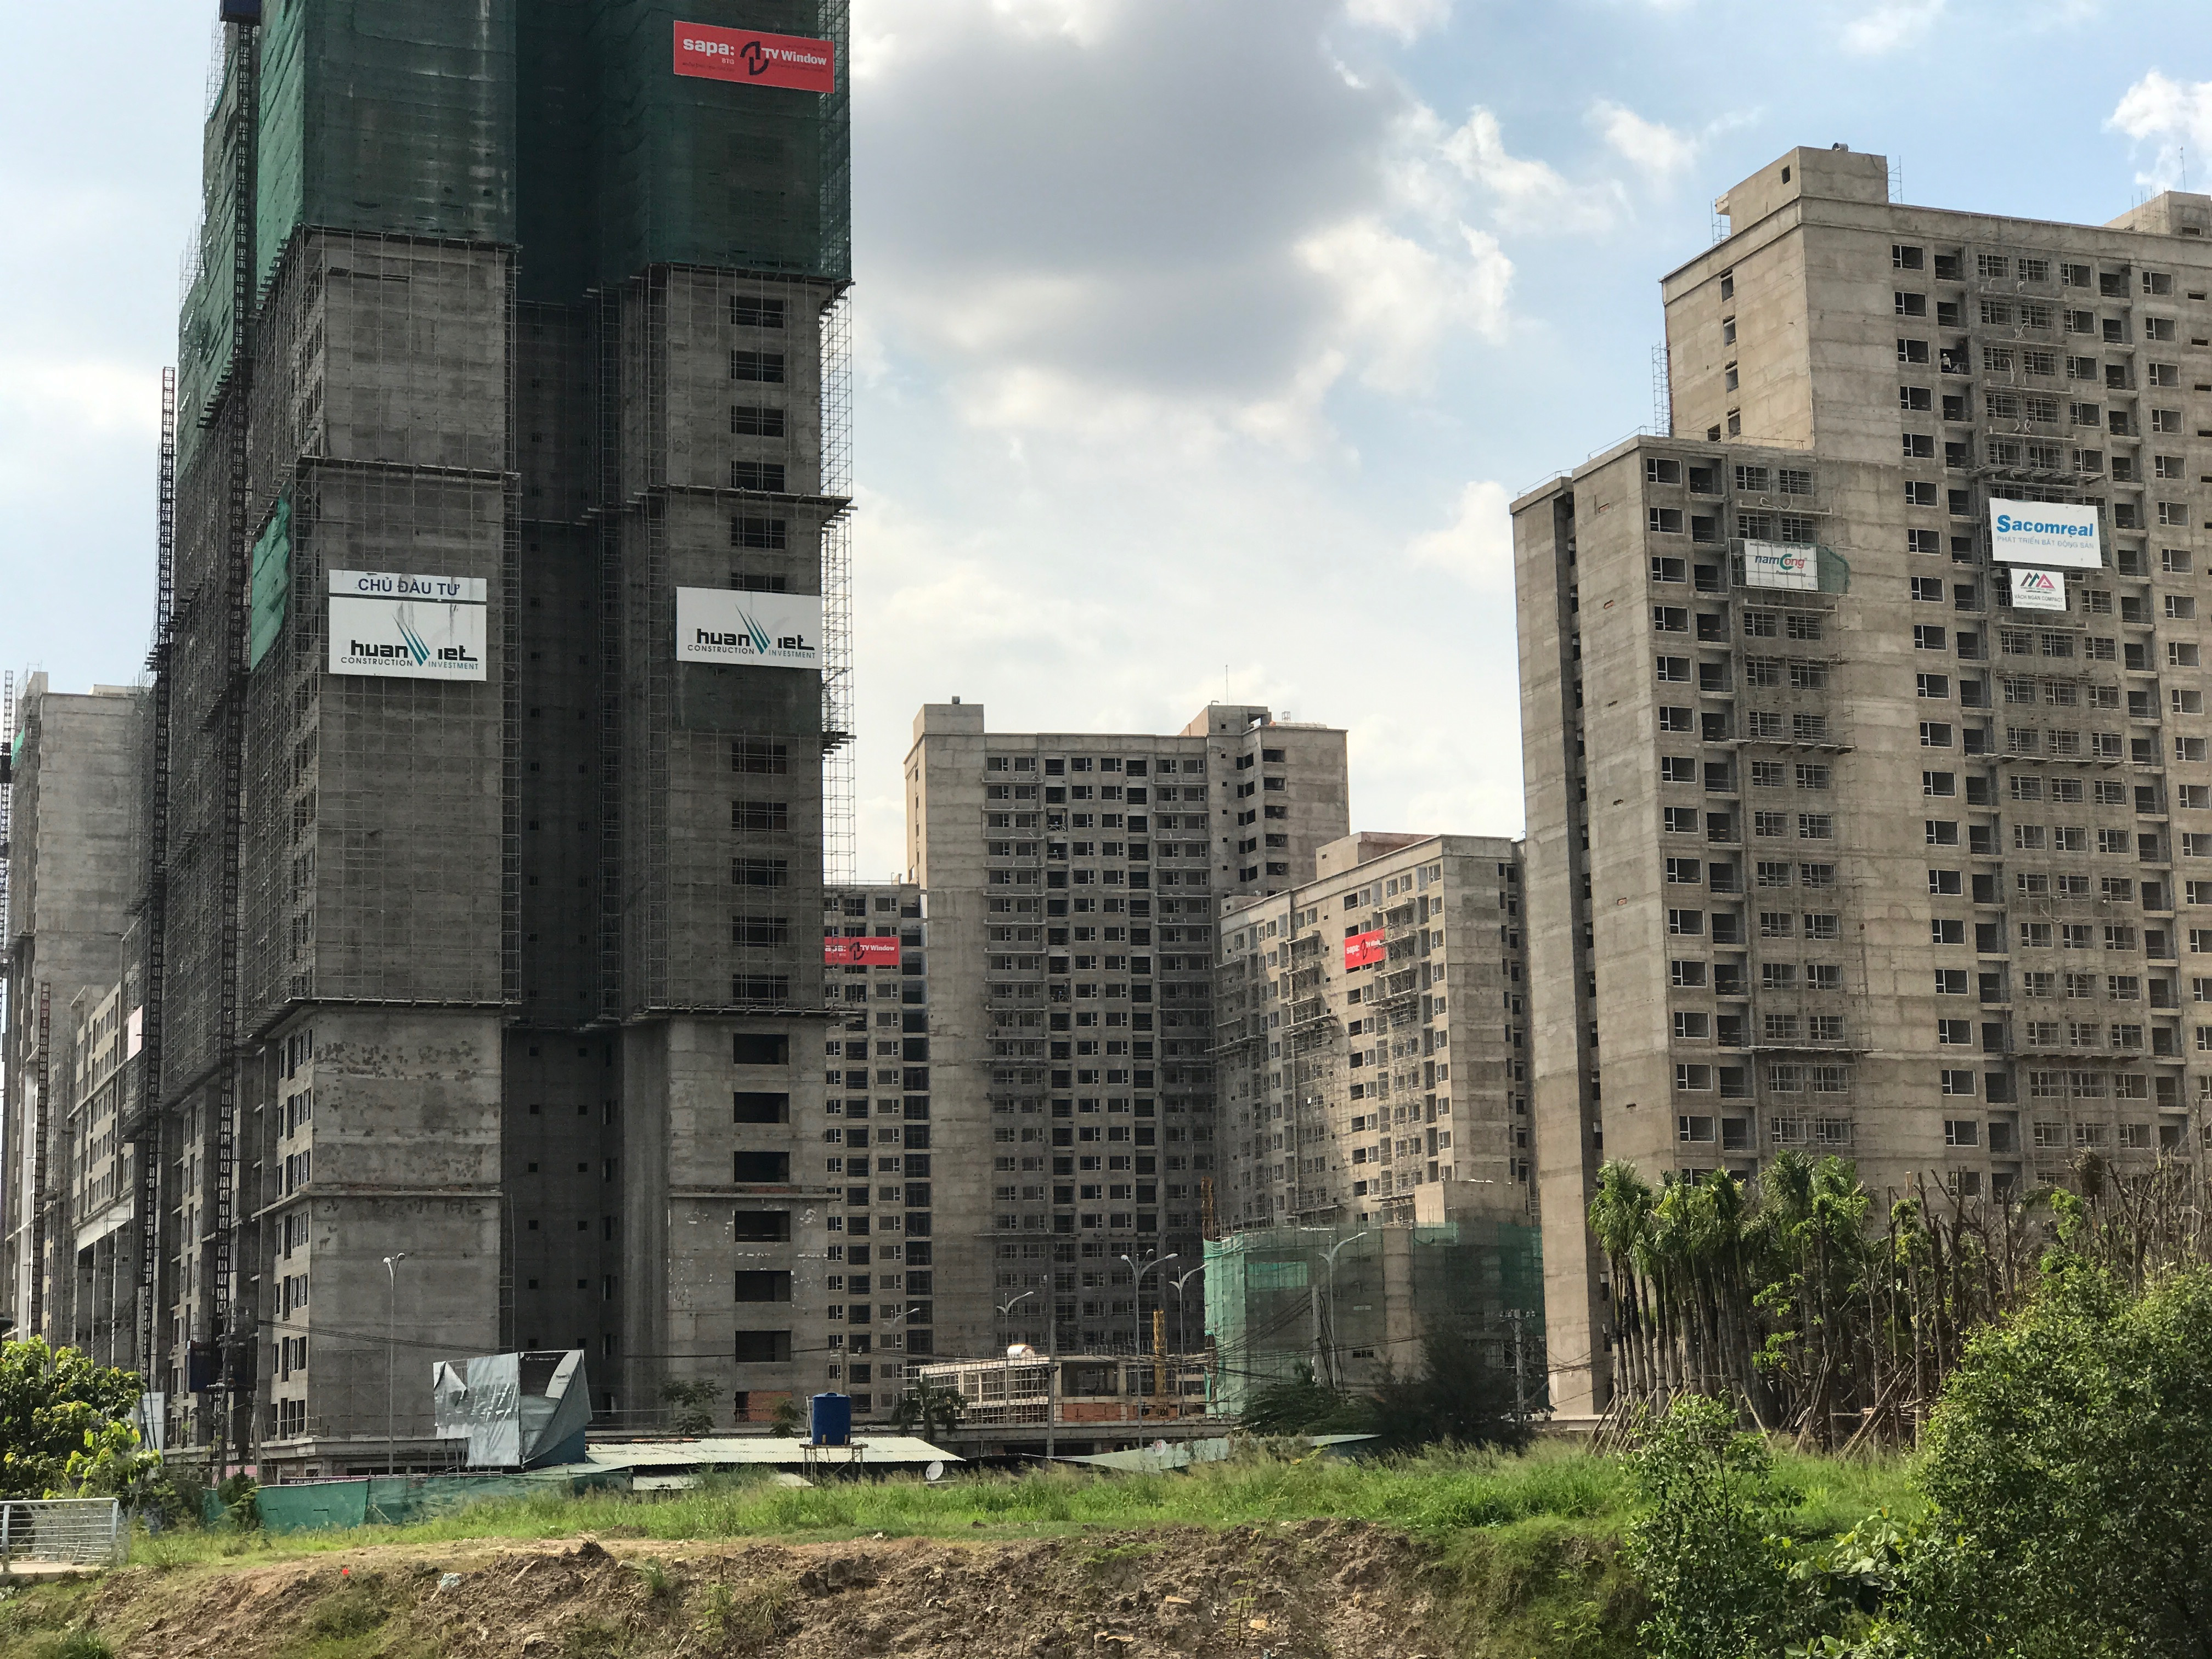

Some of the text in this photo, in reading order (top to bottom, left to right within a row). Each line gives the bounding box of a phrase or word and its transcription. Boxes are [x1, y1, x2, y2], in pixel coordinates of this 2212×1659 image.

[683, 38, 735, 57] sapa:
[781, 50, 827, 65] Window
[1996, 515, 2094, 537] Sacomreal
[358, 577, 392, 592] CHỦ
[437, 583, 460, 596] TƯ
[687, 644, 816, 659] CONSTRUCTION INVESTMENT
[341, 657, 478, 670] CONSTRUCTION INVESTMENT
